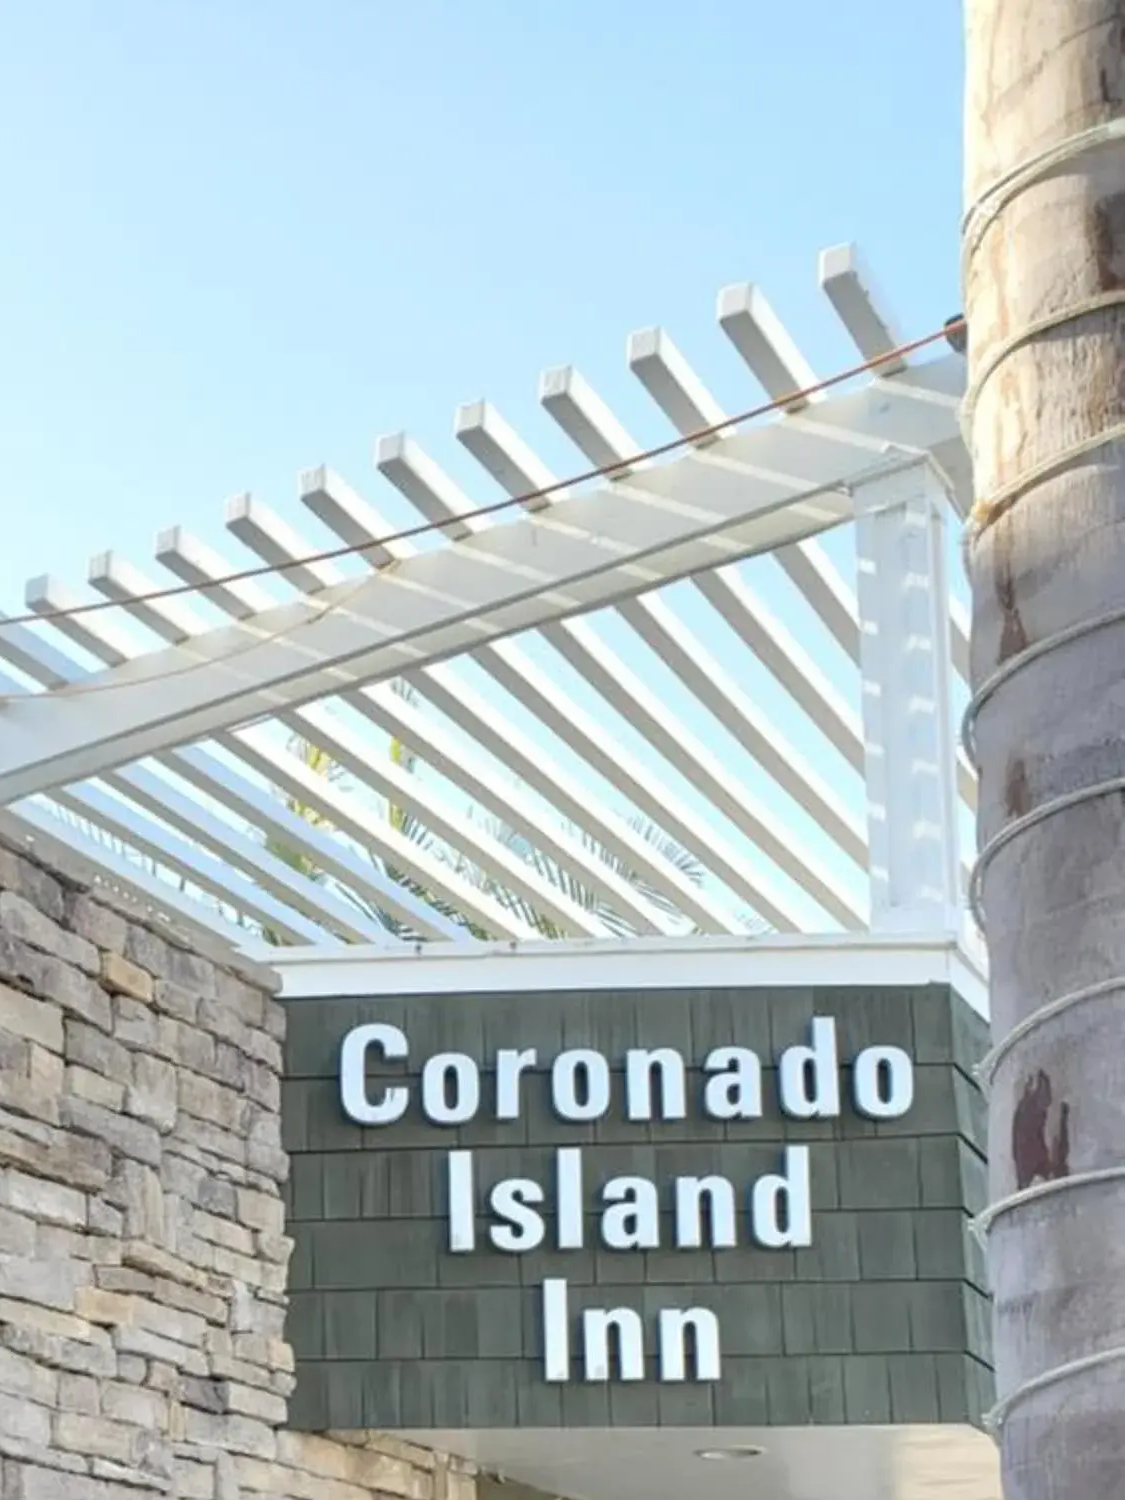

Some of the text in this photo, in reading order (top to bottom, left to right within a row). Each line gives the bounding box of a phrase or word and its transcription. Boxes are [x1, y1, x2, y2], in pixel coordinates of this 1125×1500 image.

[340, 1016, 914, 1125] Coronado
[447, 1145, 813, 1253] Island
[543, 1278, 721, 1382] Inn
